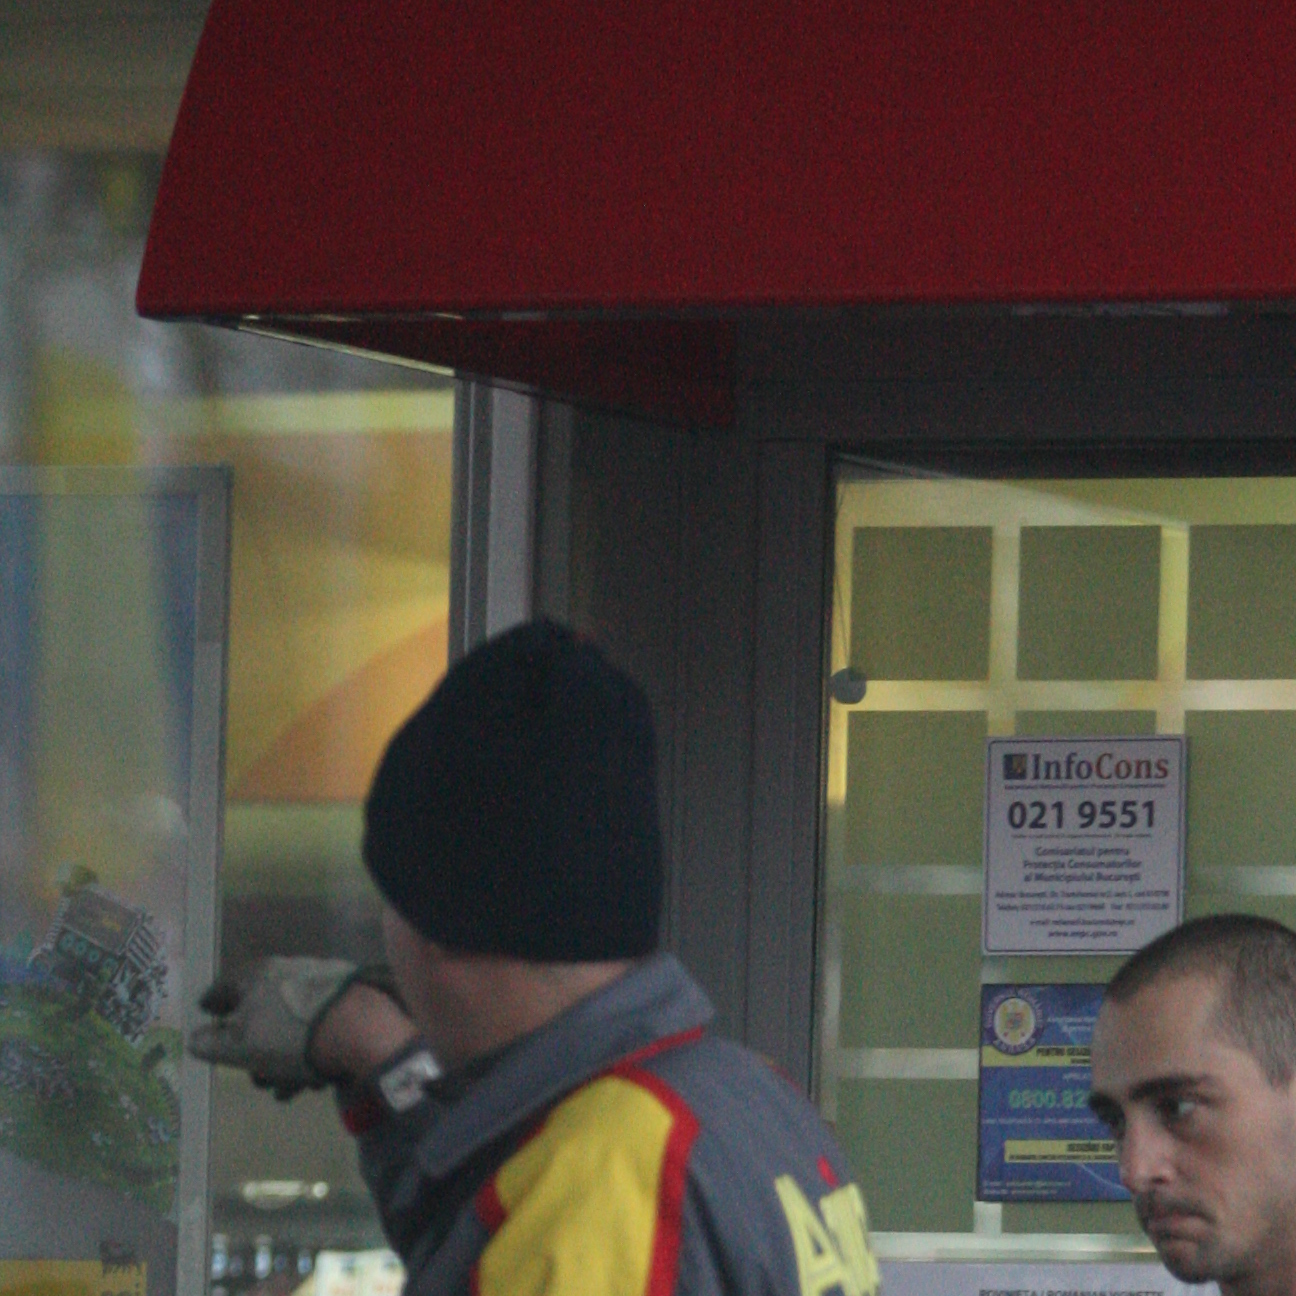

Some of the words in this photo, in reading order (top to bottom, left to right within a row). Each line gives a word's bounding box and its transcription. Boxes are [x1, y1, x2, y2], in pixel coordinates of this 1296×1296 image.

[1031, 752, 1169, 780] InfoCons
[1008, 801, 1064, 829] 021
[1077, 800, 1155, 829] 9551
